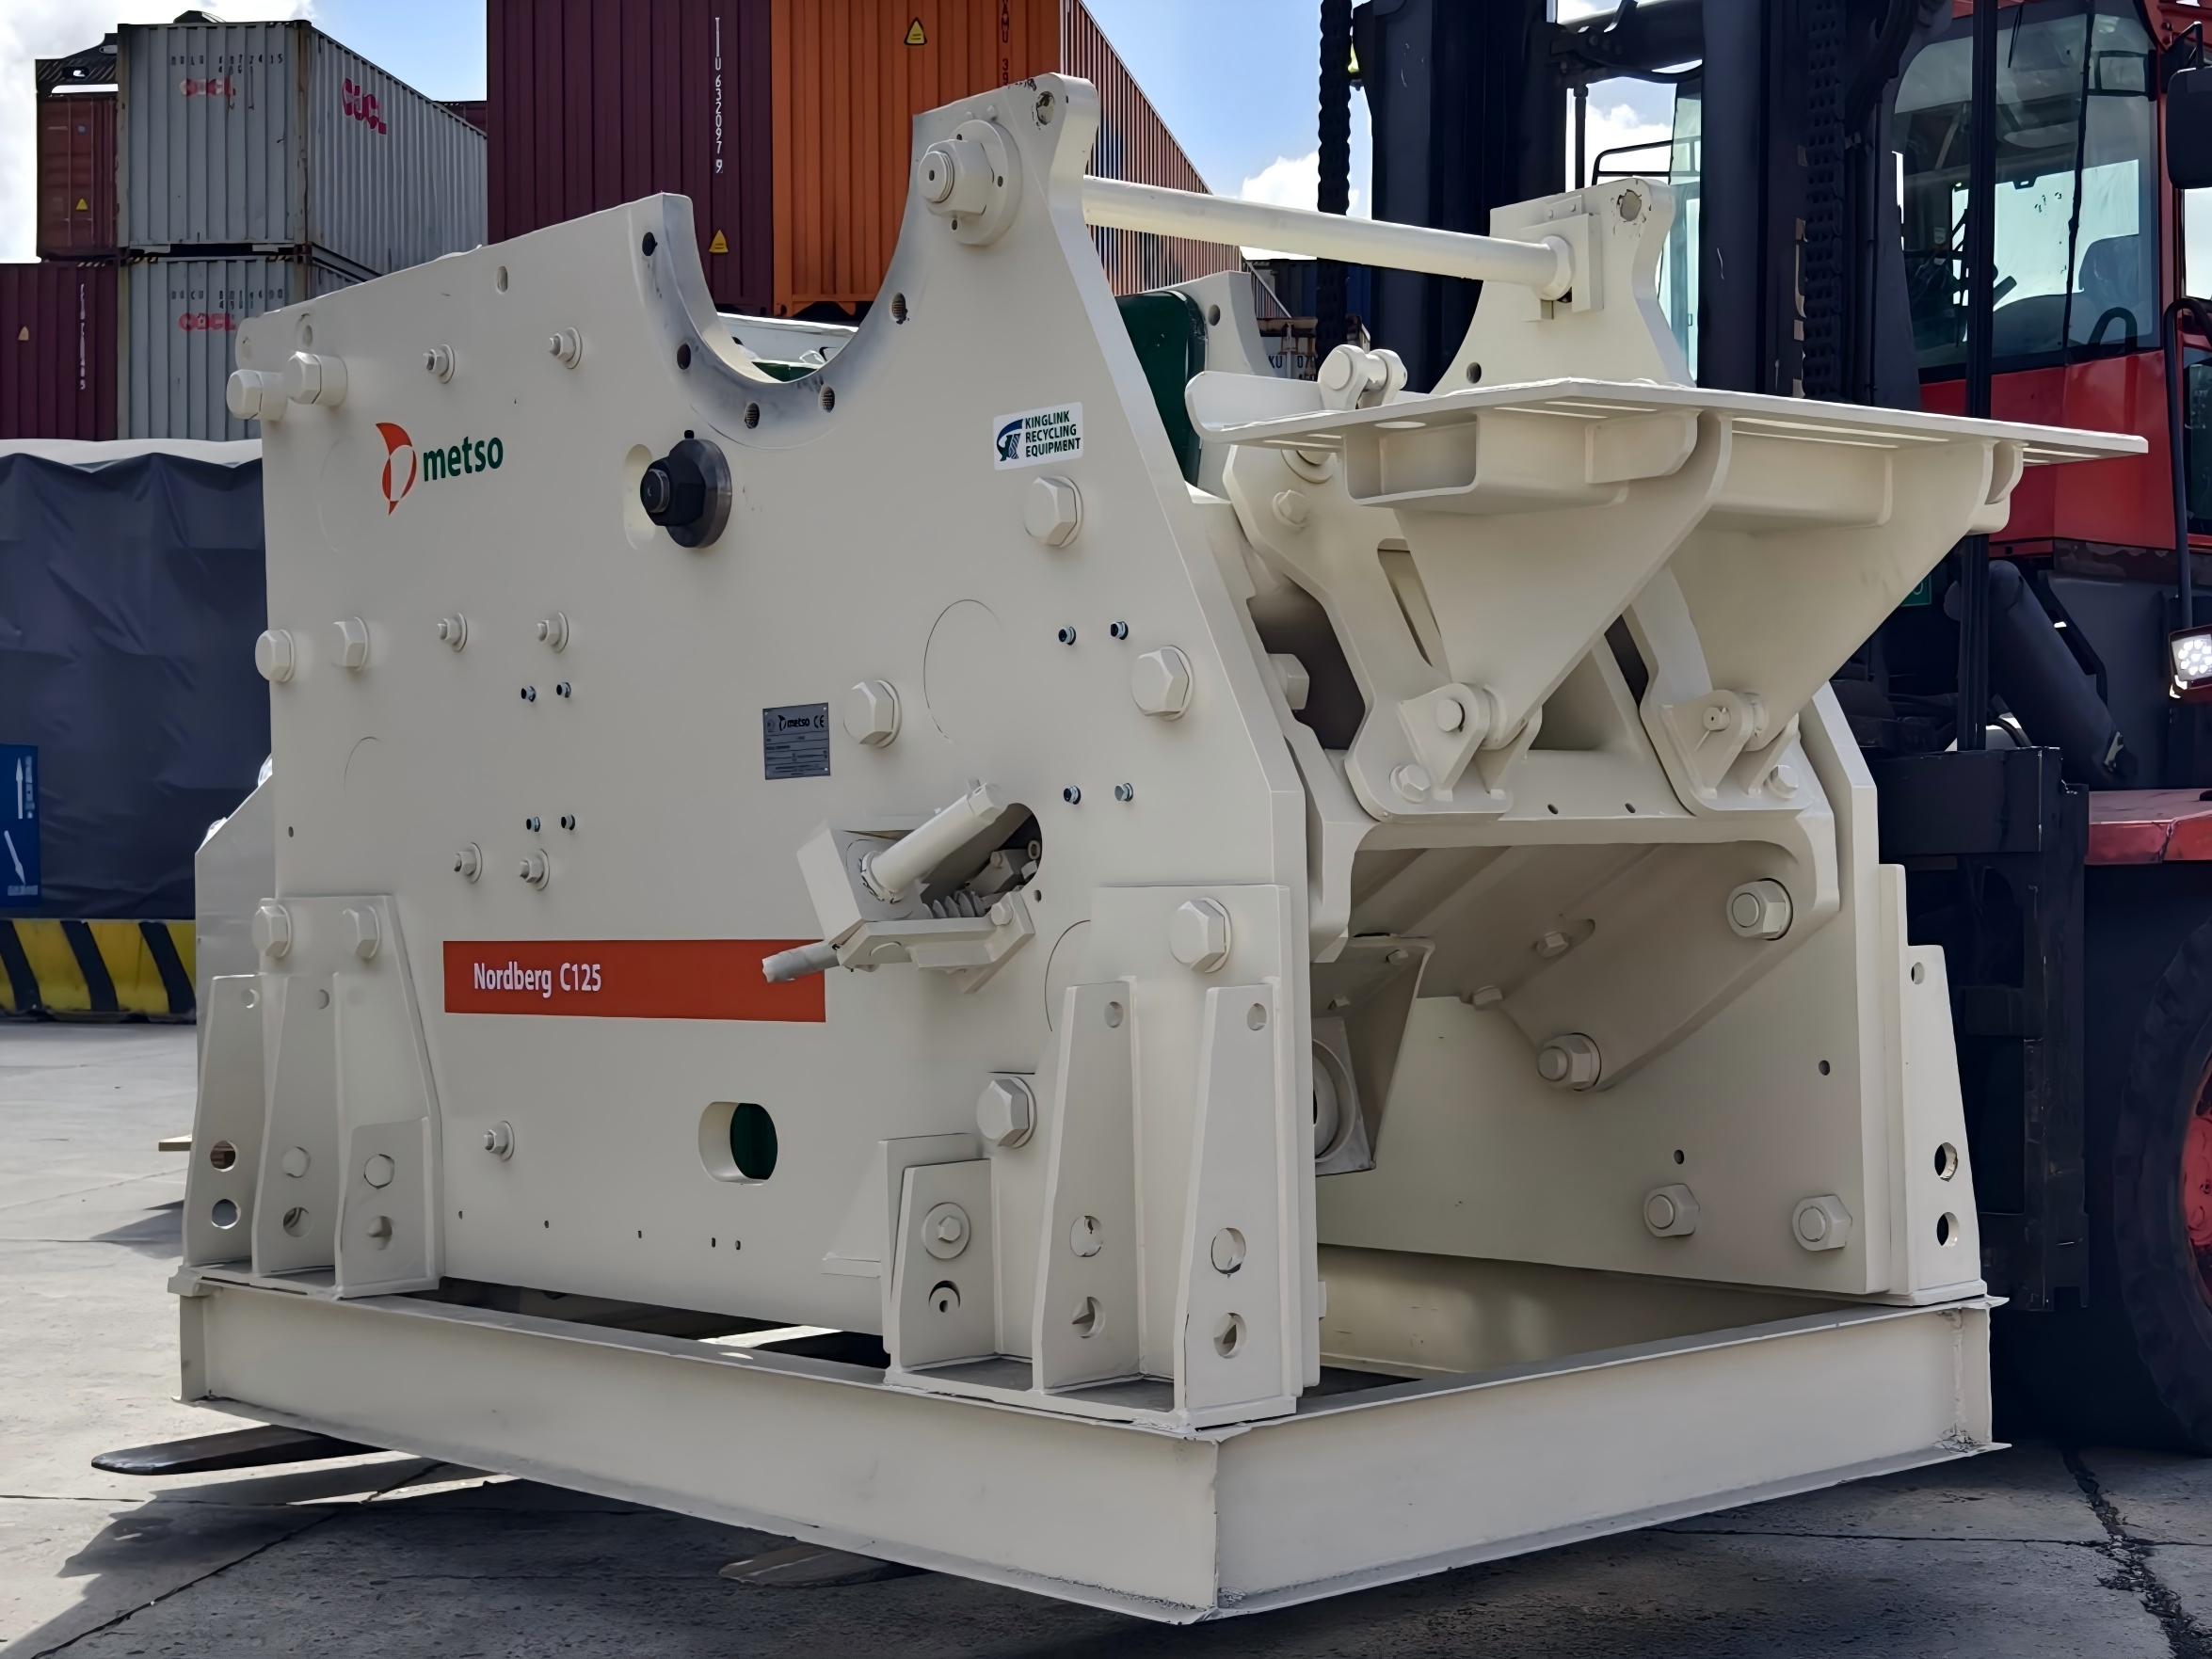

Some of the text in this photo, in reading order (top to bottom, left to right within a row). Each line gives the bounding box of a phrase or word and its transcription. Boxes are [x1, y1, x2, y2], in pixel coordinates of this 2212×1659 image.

[1025, 410, 1070, 429] KINGLINK
[1025, 423, 1077, 443] RECYCLING
[1025, 438, 1082, 458] EQUIPMENT
[423, 436, 504, 483] metso
[473, 961, 602, 998] Nordberg C125
